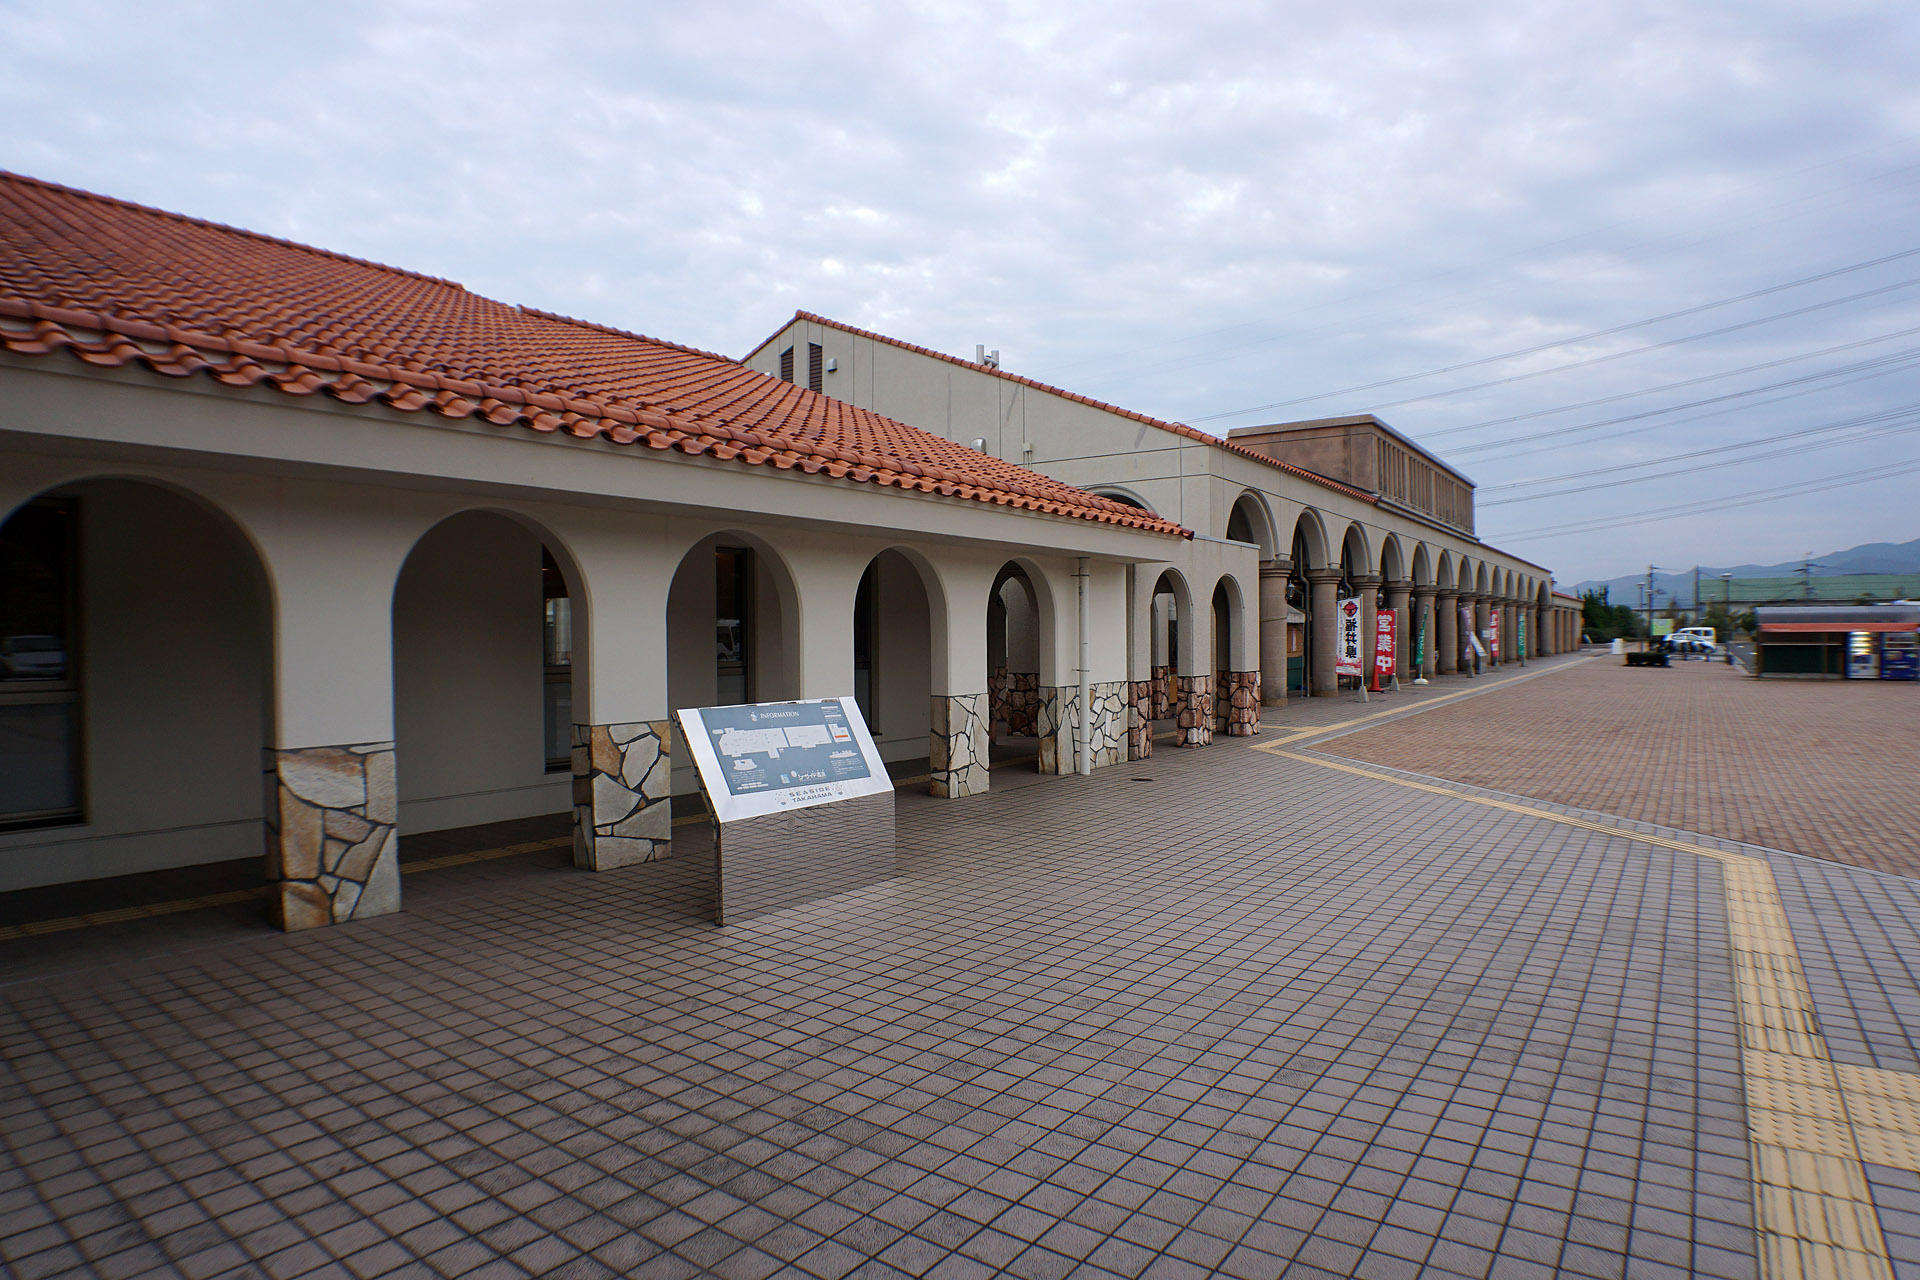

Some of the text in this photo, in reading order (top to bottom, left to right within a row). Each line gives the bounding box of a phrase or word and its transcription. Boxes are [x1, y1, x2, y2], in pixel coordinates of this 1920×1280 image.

[760, 711, 799, 719] INFORMATION
[789, 785, 831, 798] SEASIDE
[792, 791, 832, 803] TAKAHAMA
